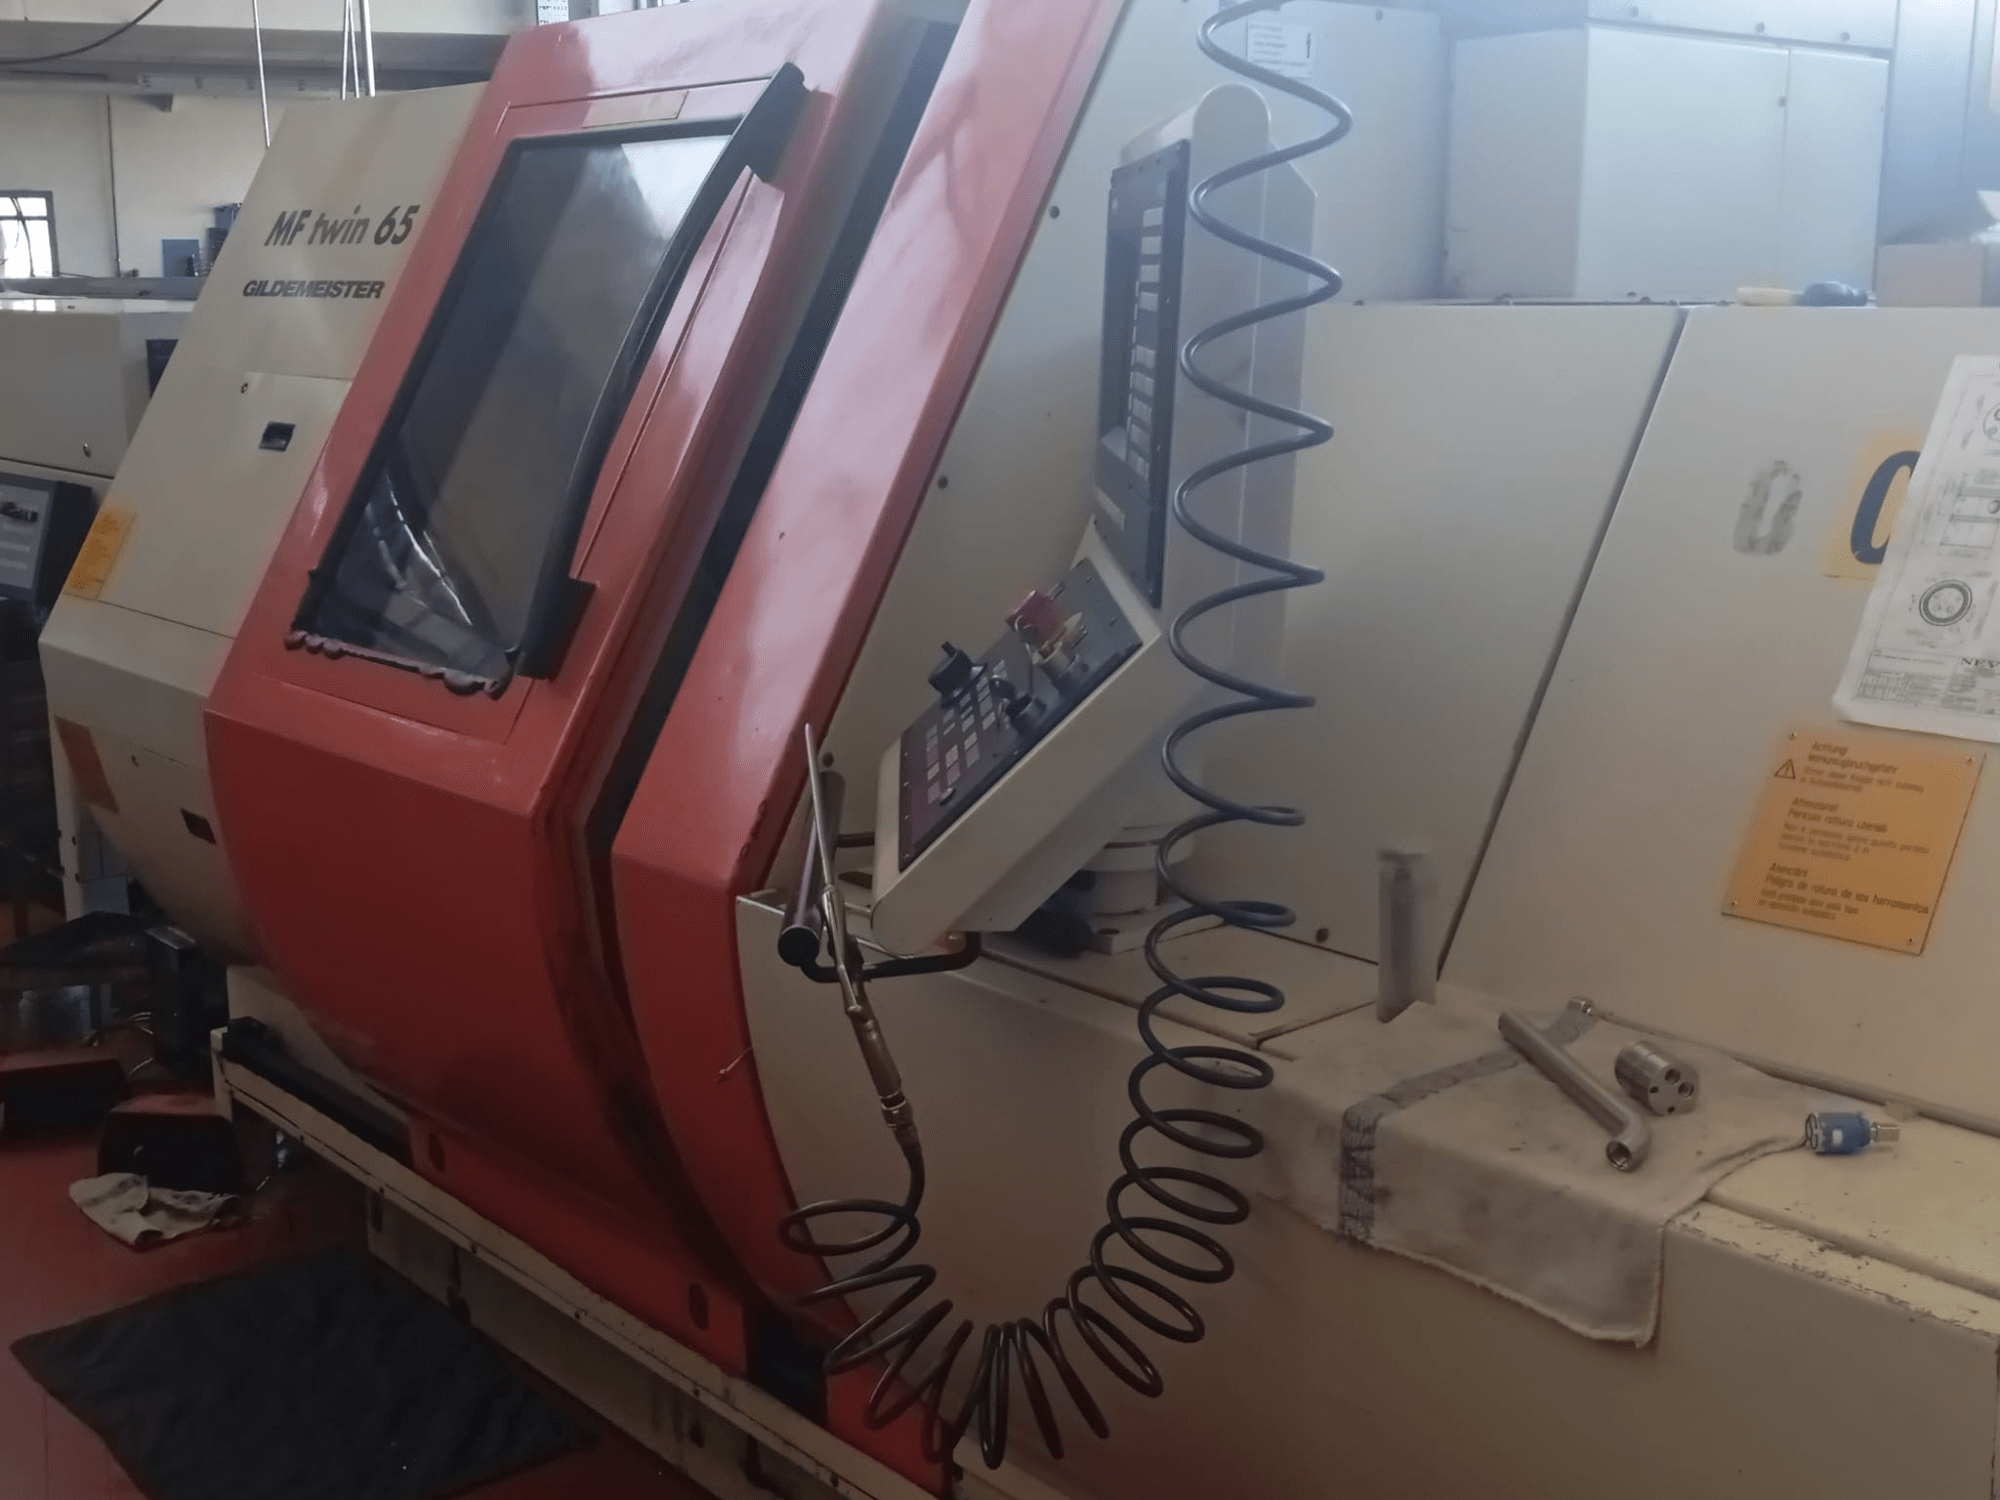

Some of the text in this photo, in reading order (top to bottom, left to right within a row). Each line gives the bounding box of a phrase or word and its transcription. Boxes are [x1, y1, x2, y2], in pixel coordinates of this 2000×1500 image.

[263, 204, 421, 247] MF twin 65
[242, 279, 386, 299] GILDEMEISTER
